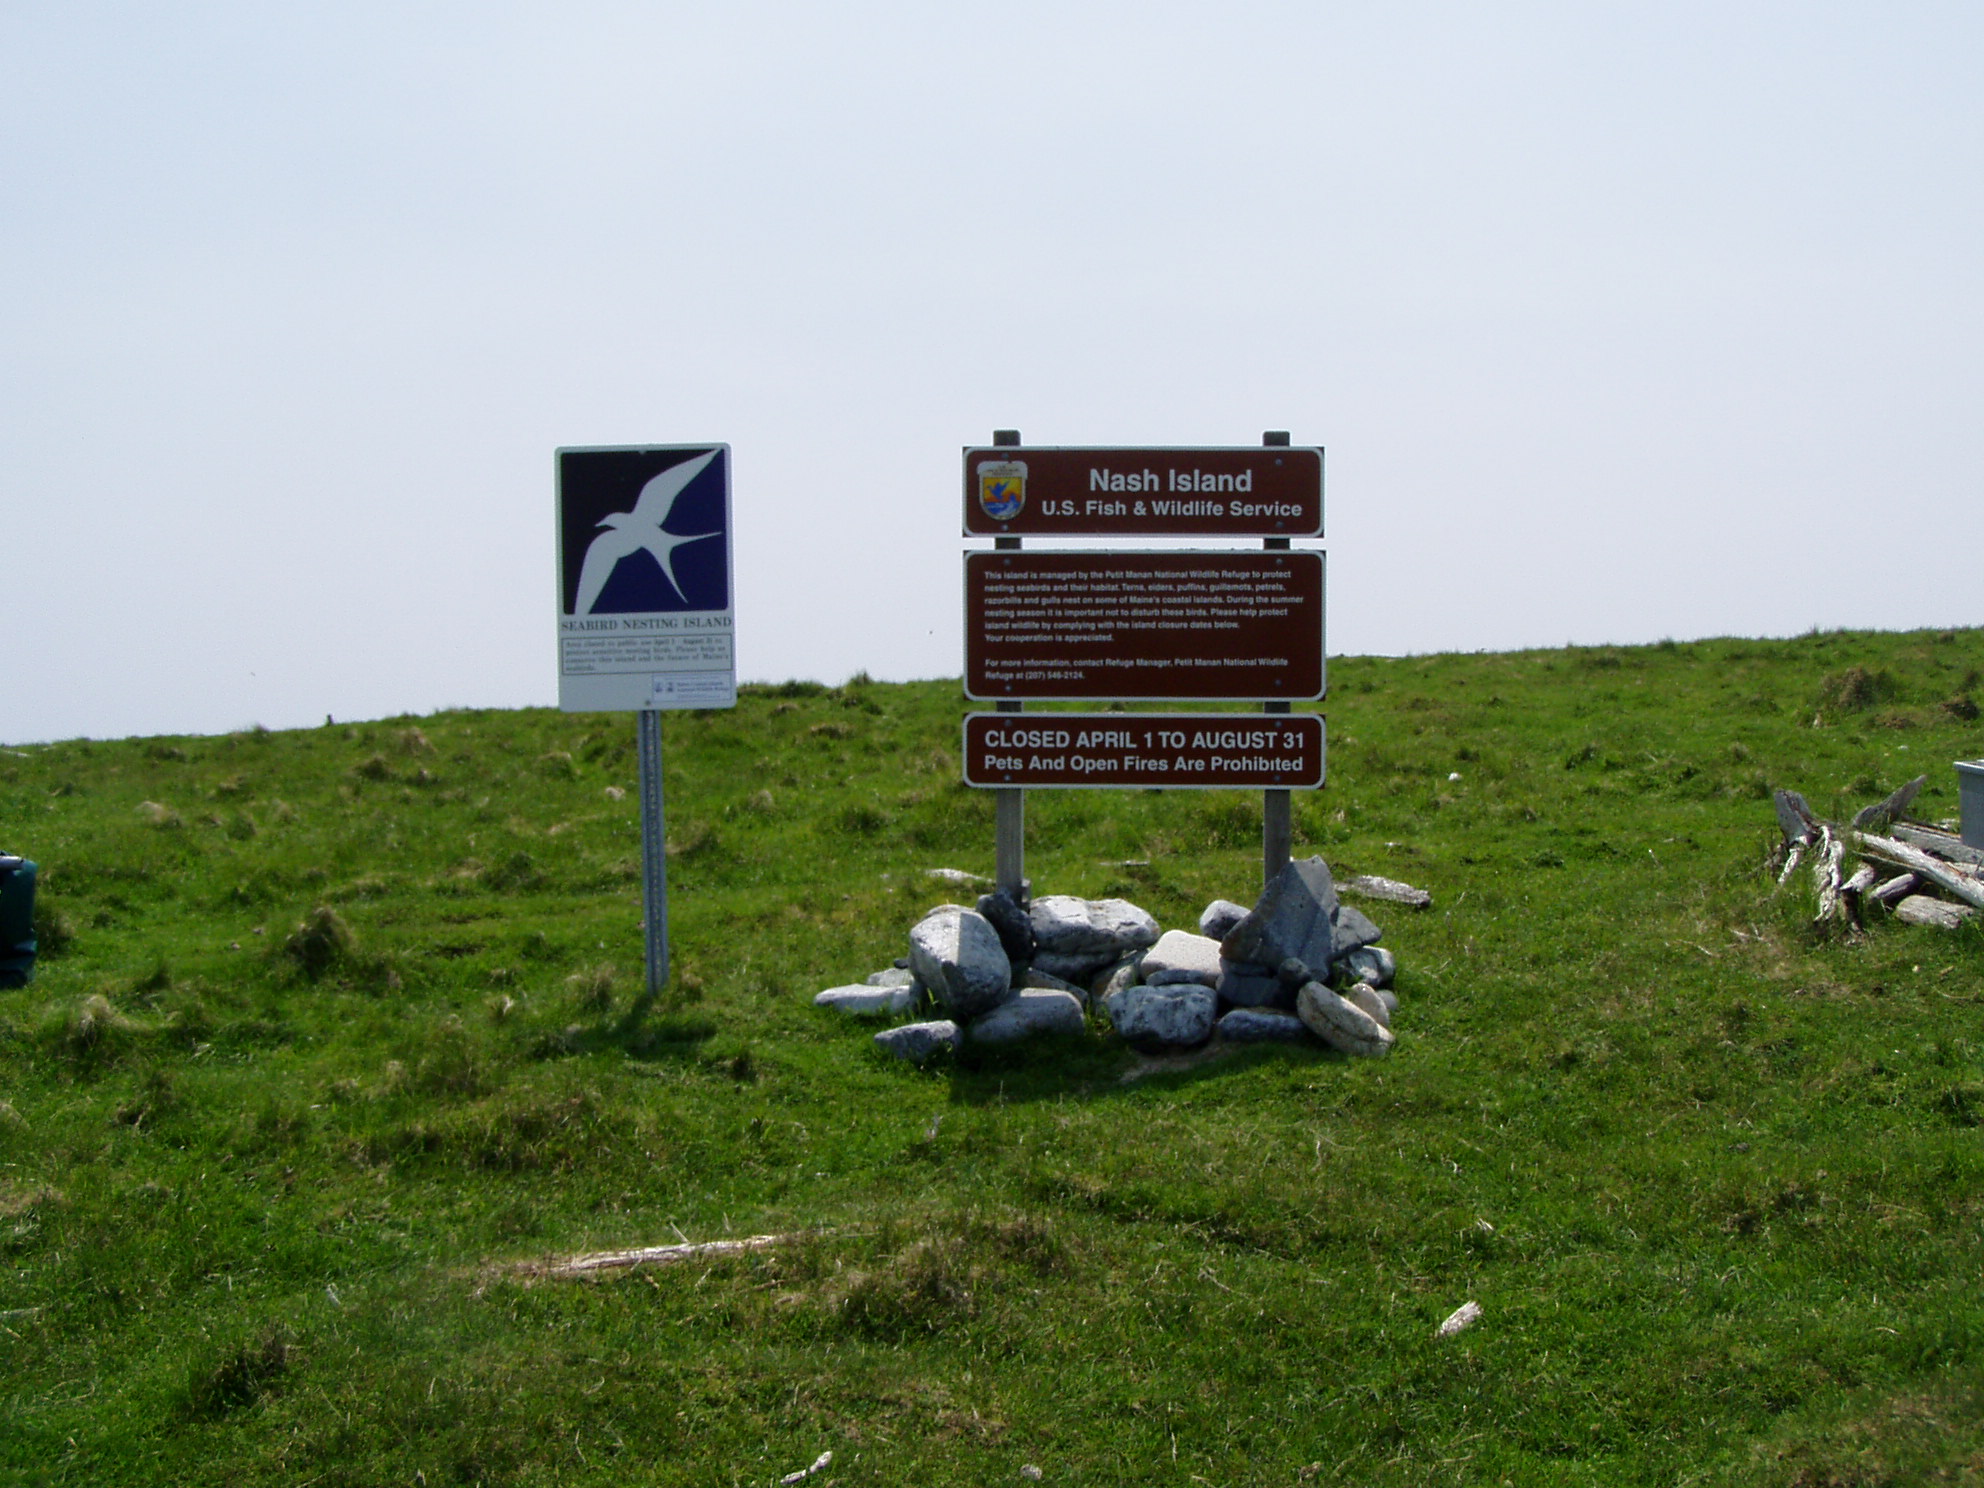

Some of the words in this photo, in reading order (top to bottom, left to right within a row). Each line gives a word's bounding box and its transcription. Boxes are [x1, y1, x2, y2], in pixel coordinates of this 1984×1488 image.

[1090, 469, 1159, 491] Nash
[1169, 469, 1252, 492] Island
[1042, 500, 1079, 515] U.S.
[1086, 500, 1126, 515] Fish
[1133, 501, 1146, 515] &
[1152, 501, 1224, 516] Wildlife
[1230, 501, 1302, 516] Service
[985, 571, 1002, 579] This
[1040, 572, 1076, 580] managed
[1078, 572, 1088, 580] by
[1189, 570, 1219, 578] Wildlife
[1221, 570, 1250, 580] Refuge
[1262, 571, 1291, 579] protect
[985, 584, 1014, 593] nesting
[1041, 596, 1061, 606] gulls
[1119, 596, 1127, 604] of
[1227, 596, 1254, 605] During
[985, 610, 1015, 618] nesting
[1064, 609, 1103, 617] important
[1211, 608, 1238, 616] Please
[1239, 608, 1257, 617] help
[1259, 608, 1288, 617] protect
[562, 619, 617, 631] SEABIRD
[623, 618, 677, 630] NESTING
[684, 617, 731, 629] ISLAND
[1011, 621, 1040, 629] wildlife
[1041, 622, 1051, 630] by
[1053, 622, 1096, 630] complying
[1131, 621, 1156, 629] island
[985, 634, 1003, 642] Your
[985, 659, 999, 667] For
[1105, 658, 1134, 668] Refuge
[1174, 658, 1193, 666] Petit
[1194, 658, 1222, 666] Manan
[1224, 658, 1257, 666] National
[1258, 658, 1288, 666] Wildlife
[985, 671, 1014, 681] Refuge
[985, 730, 1070, 747] CLOSED
[1076, 731, 1137, 748] APRIL
[1144, 732, 1152, 748] 1
[1158, 731, 1186, 748] TO
[1192, 732, 1278, 748] AUGUST
[1283, 732, 1303, 749] 31
[985, 755, 1023, 770] Pets
[1029, 755, 1065, 770] And
[1070, 755, 1118, 773] Open
[1124, 756, 1168, 771] Fires
[1174, 756, 1205, 771] Are
[1211, 756, 1303, 771] Prohibited
